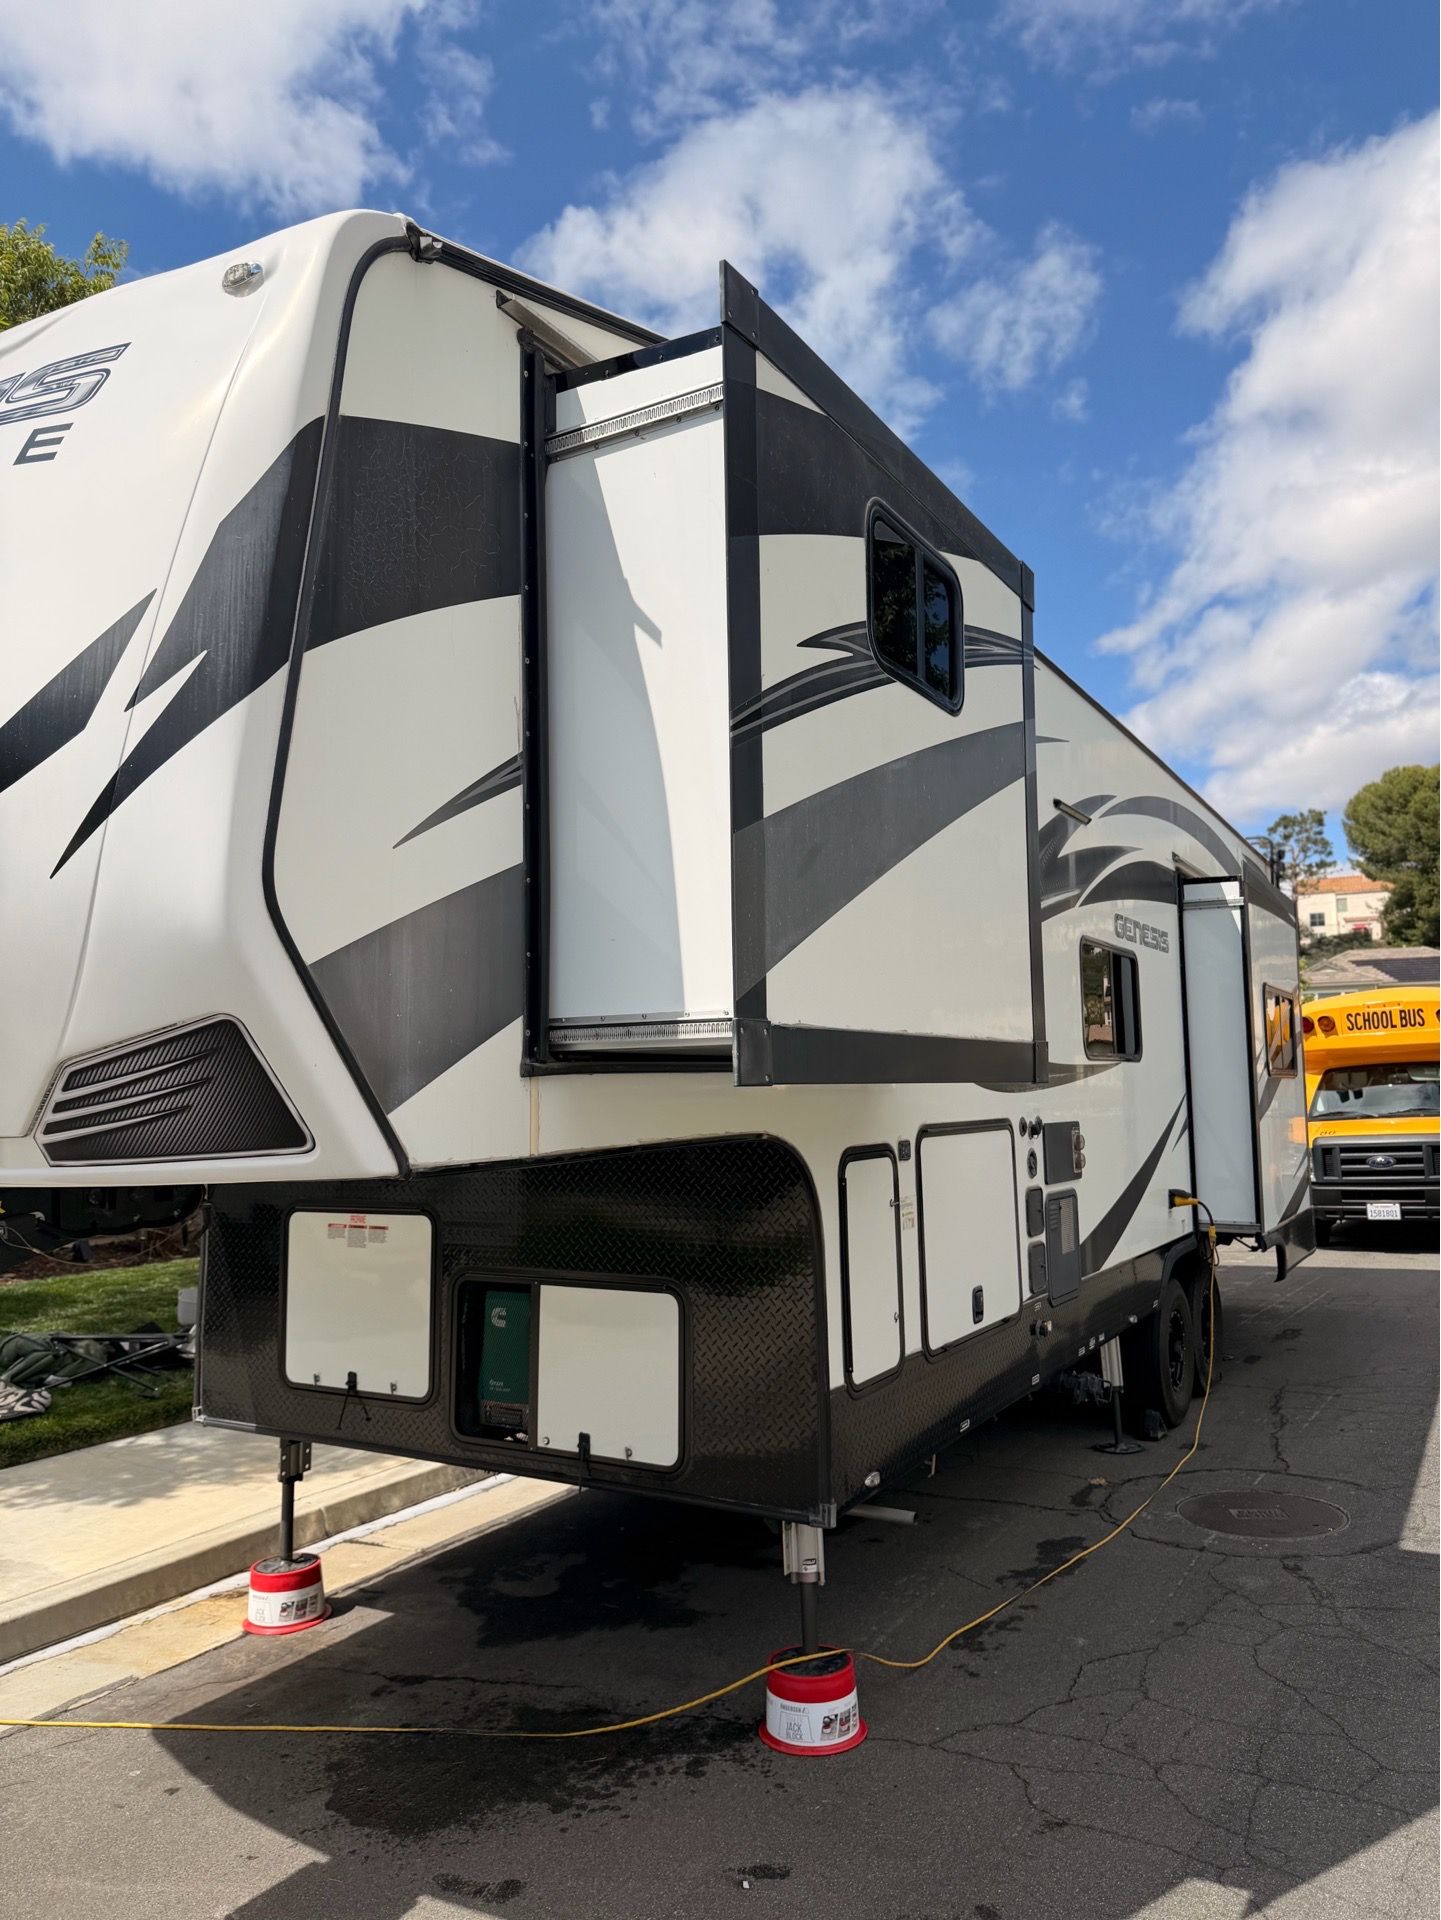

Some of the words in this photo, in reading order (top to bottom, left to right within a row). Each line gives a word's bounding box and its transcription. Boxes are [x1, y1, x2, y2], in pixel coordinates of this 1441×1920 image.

[1114, 913, 1169, 953] GENESIS
[1346, 1010, 1398, 1031] SCHOOL
[1399, 1008, 1425, 1028] BUS
